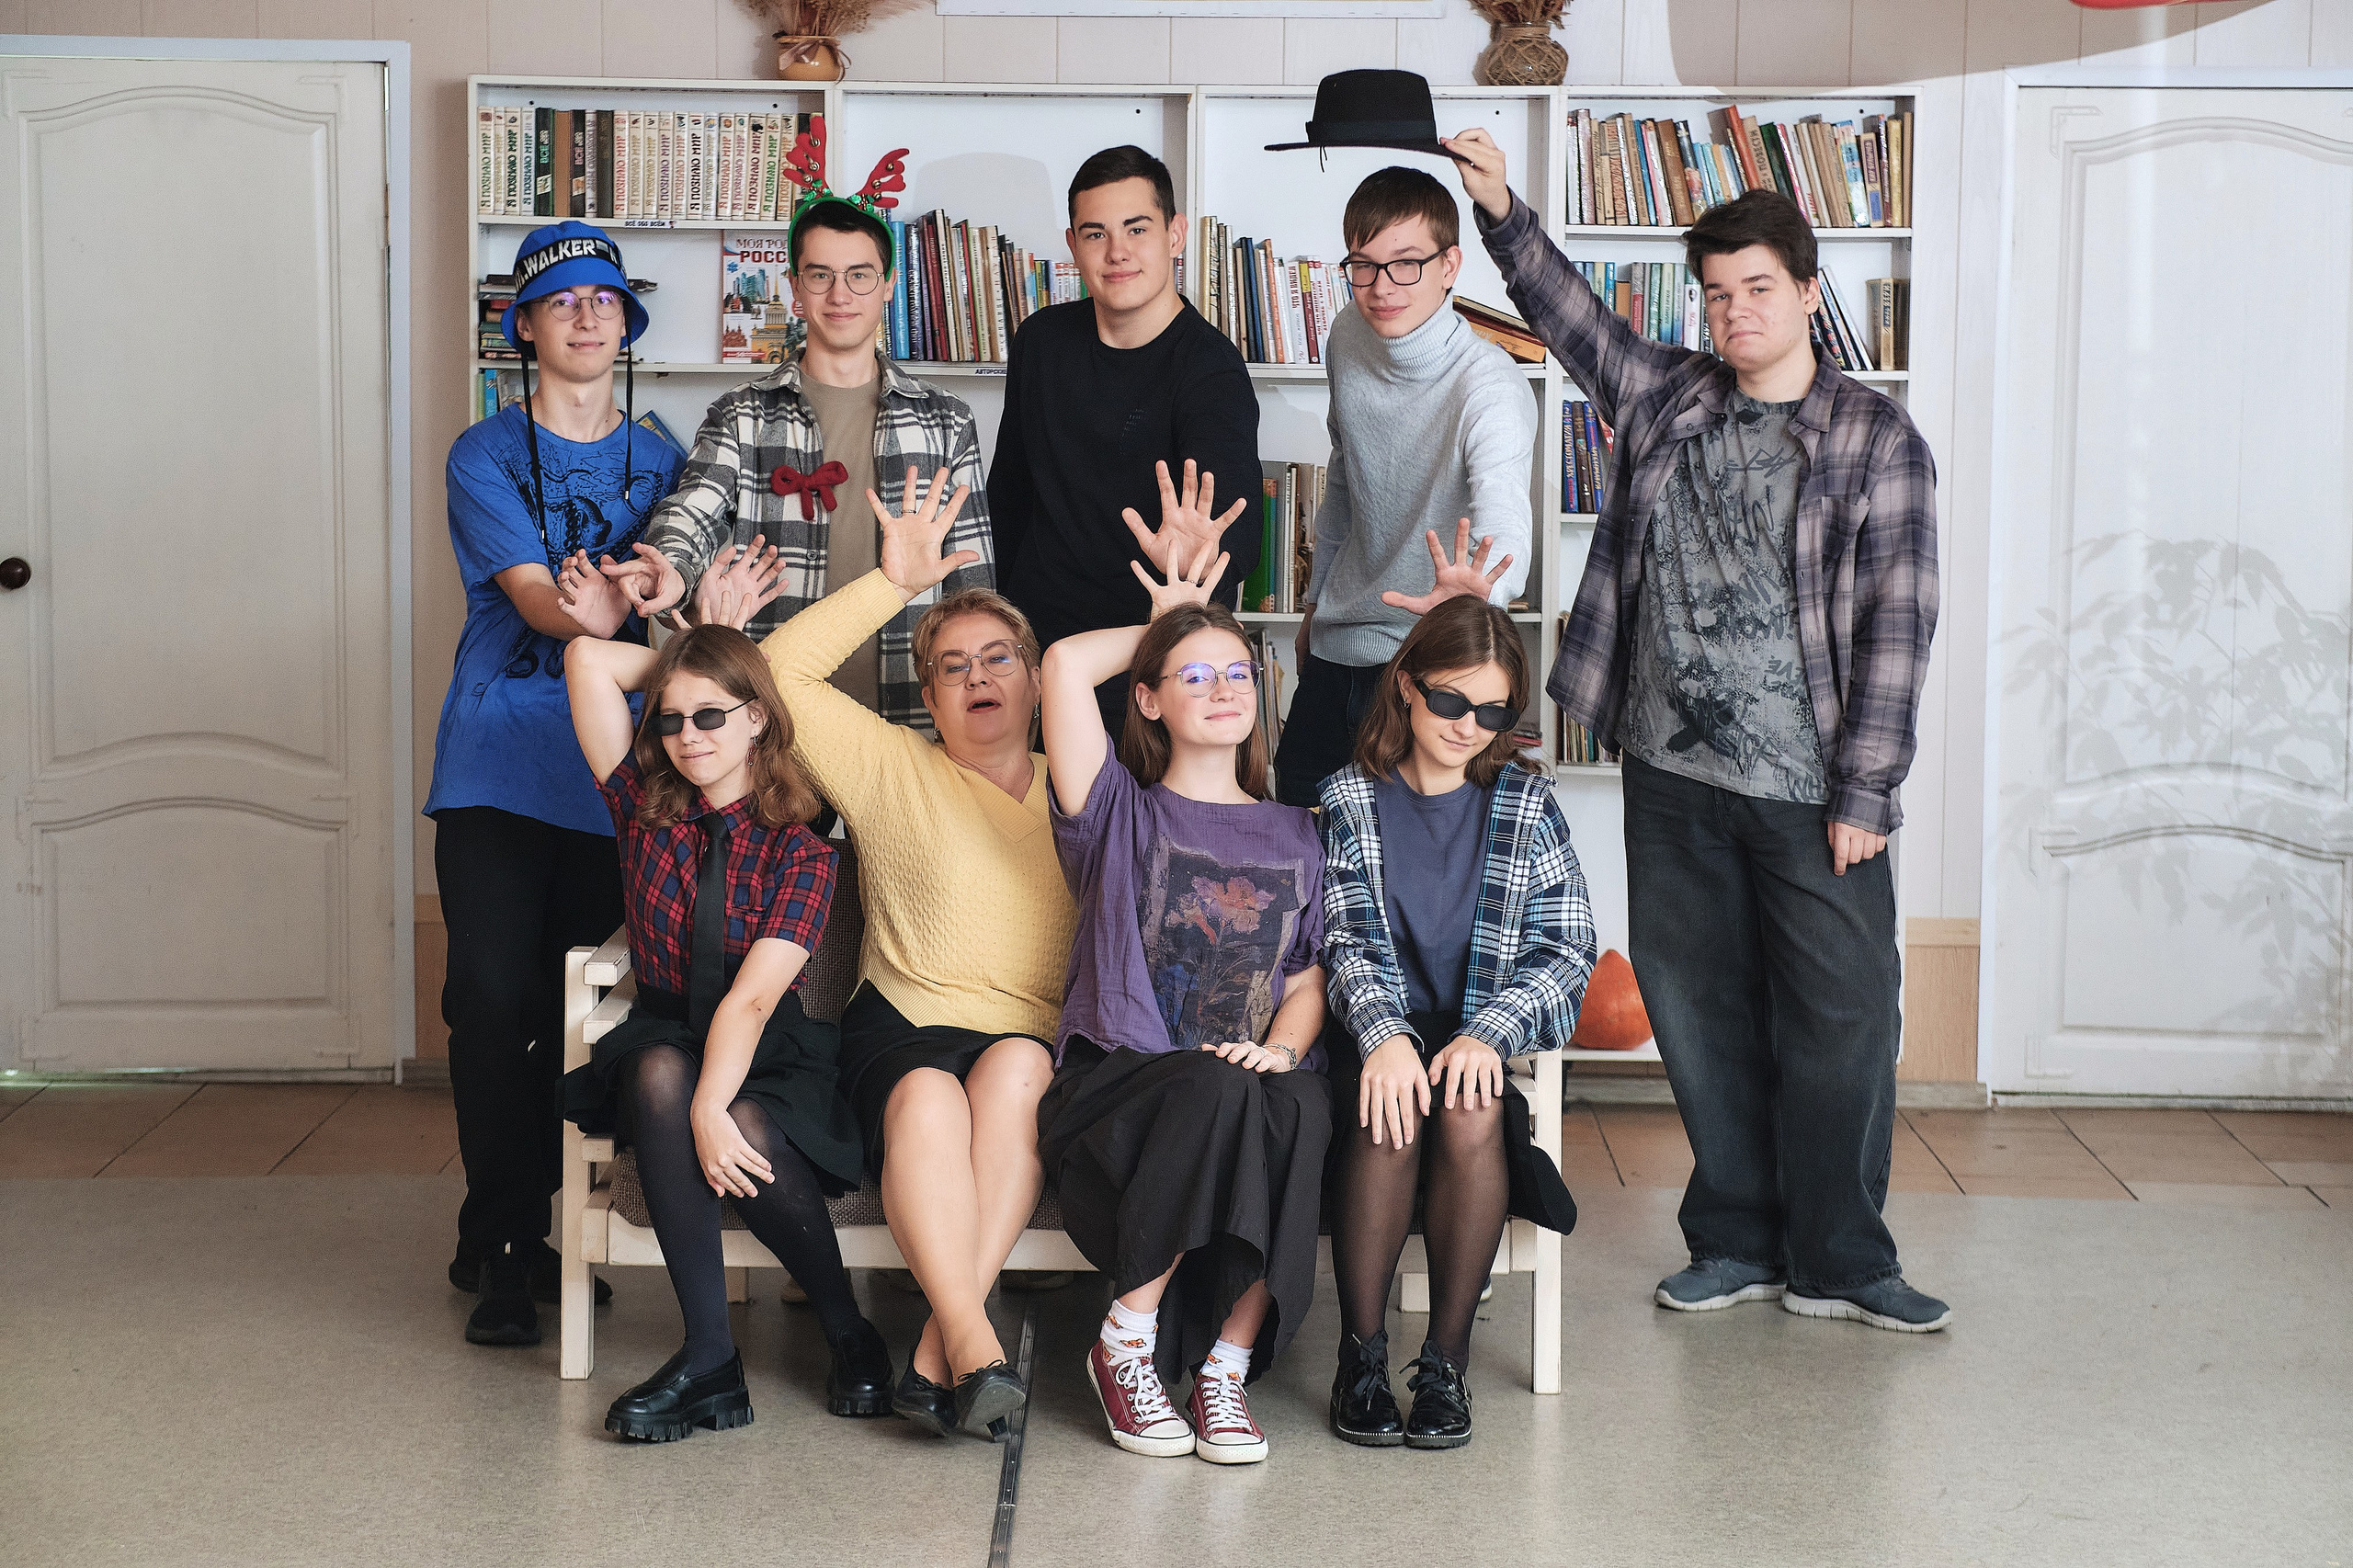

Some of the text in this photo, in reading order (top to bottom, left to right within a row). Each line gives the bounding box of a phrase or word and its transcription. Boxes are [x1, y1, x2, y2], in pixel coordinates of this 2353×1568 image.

[691, 133, 701, 155] МИР
[721, 136, 731, 157] МИР
[750, 132, 761, 154] МИР
[767, 135, 778, 157] МИР
[1749, 130, 1768, 171] ПОВЕСТИ
[615, 135, 625, 211] Я ПОЗНАЮ МИР
[659, 134, 671, 211] Я ПОЗНАЮ МИР
[690, 158, 701, 200] ПОЗНАЮ
[719, 159, 731, 199] ПОЗНАЮ
[748, 157, 760, 201] ПОЗНАЮ
[764, 161, 777, 203] ПОЗНАЮ
[779, 161, 790, 203] ПОЗНЮ
[736, 239, 763, 249] МОЯ
[739, 251, 790, 263] РОСС
[1288, 266, 1298, 288] ВИДЕЛ
[1291, 295, 1300, 309] ЧТО
